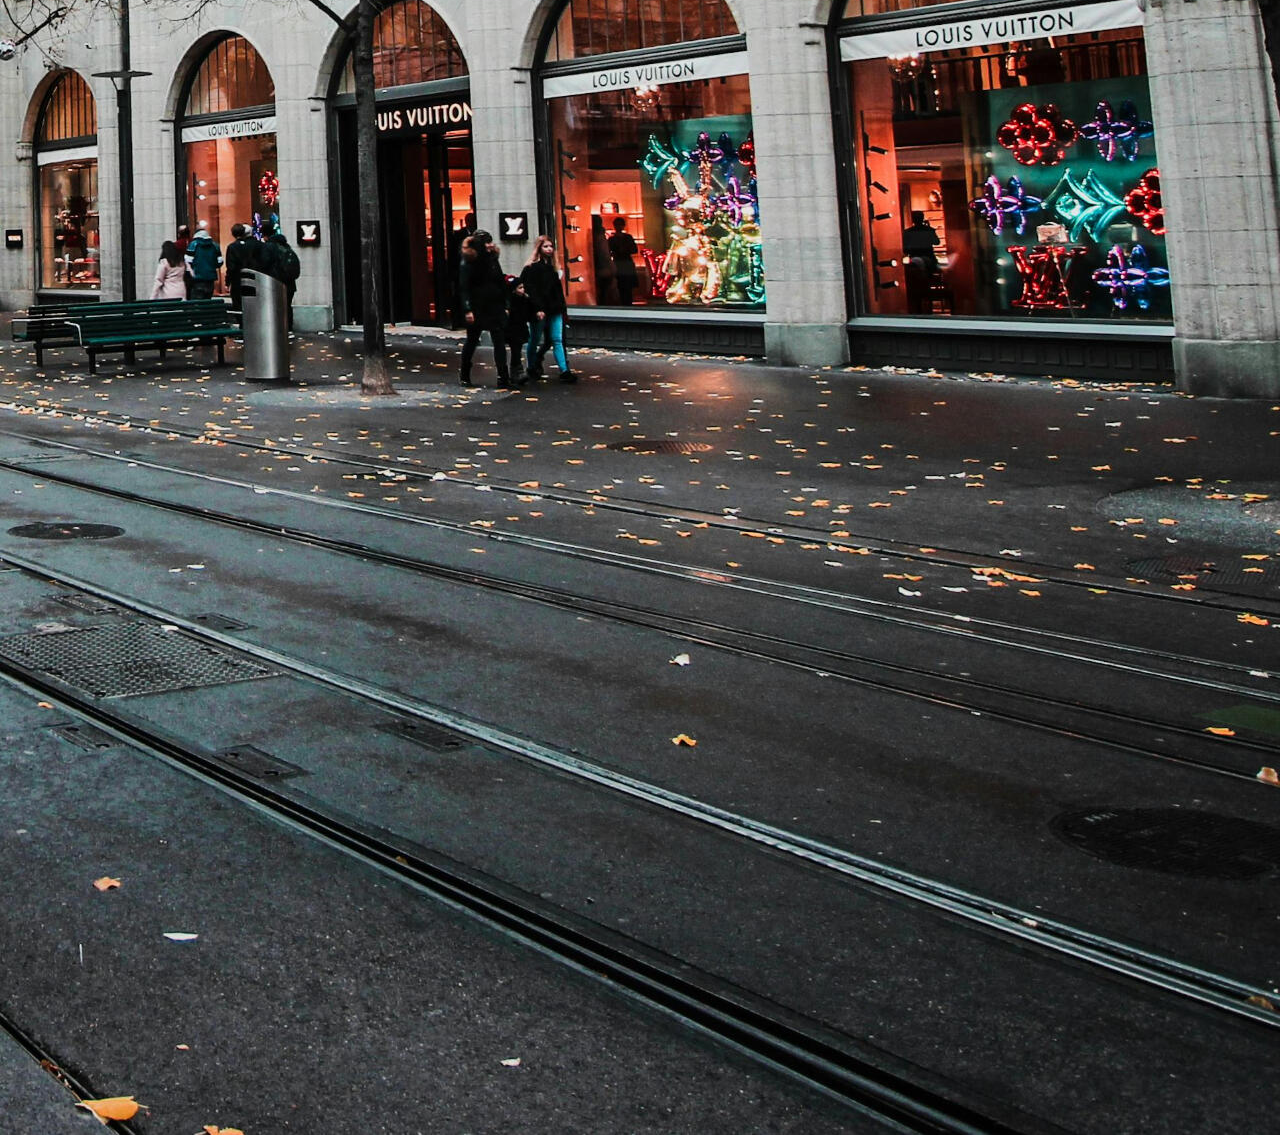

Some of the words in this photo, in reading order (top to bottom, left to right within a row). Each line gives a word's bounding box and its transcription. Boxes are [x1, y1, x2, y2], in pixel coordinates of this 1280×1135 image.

[916, 24, 973, 47] LOUIS
[982, 11, 1073, 38] VUITTON
[592, 70, 630, 88] LOUIS
[635, 62, 695, 82] VUITTON
[207, 125, 229, 137] LOUIS
[231, 120, 264, 134] VUITTON
[375, 110, 402, 131] UIS
[406, 101, 472, 127] VUITTON
